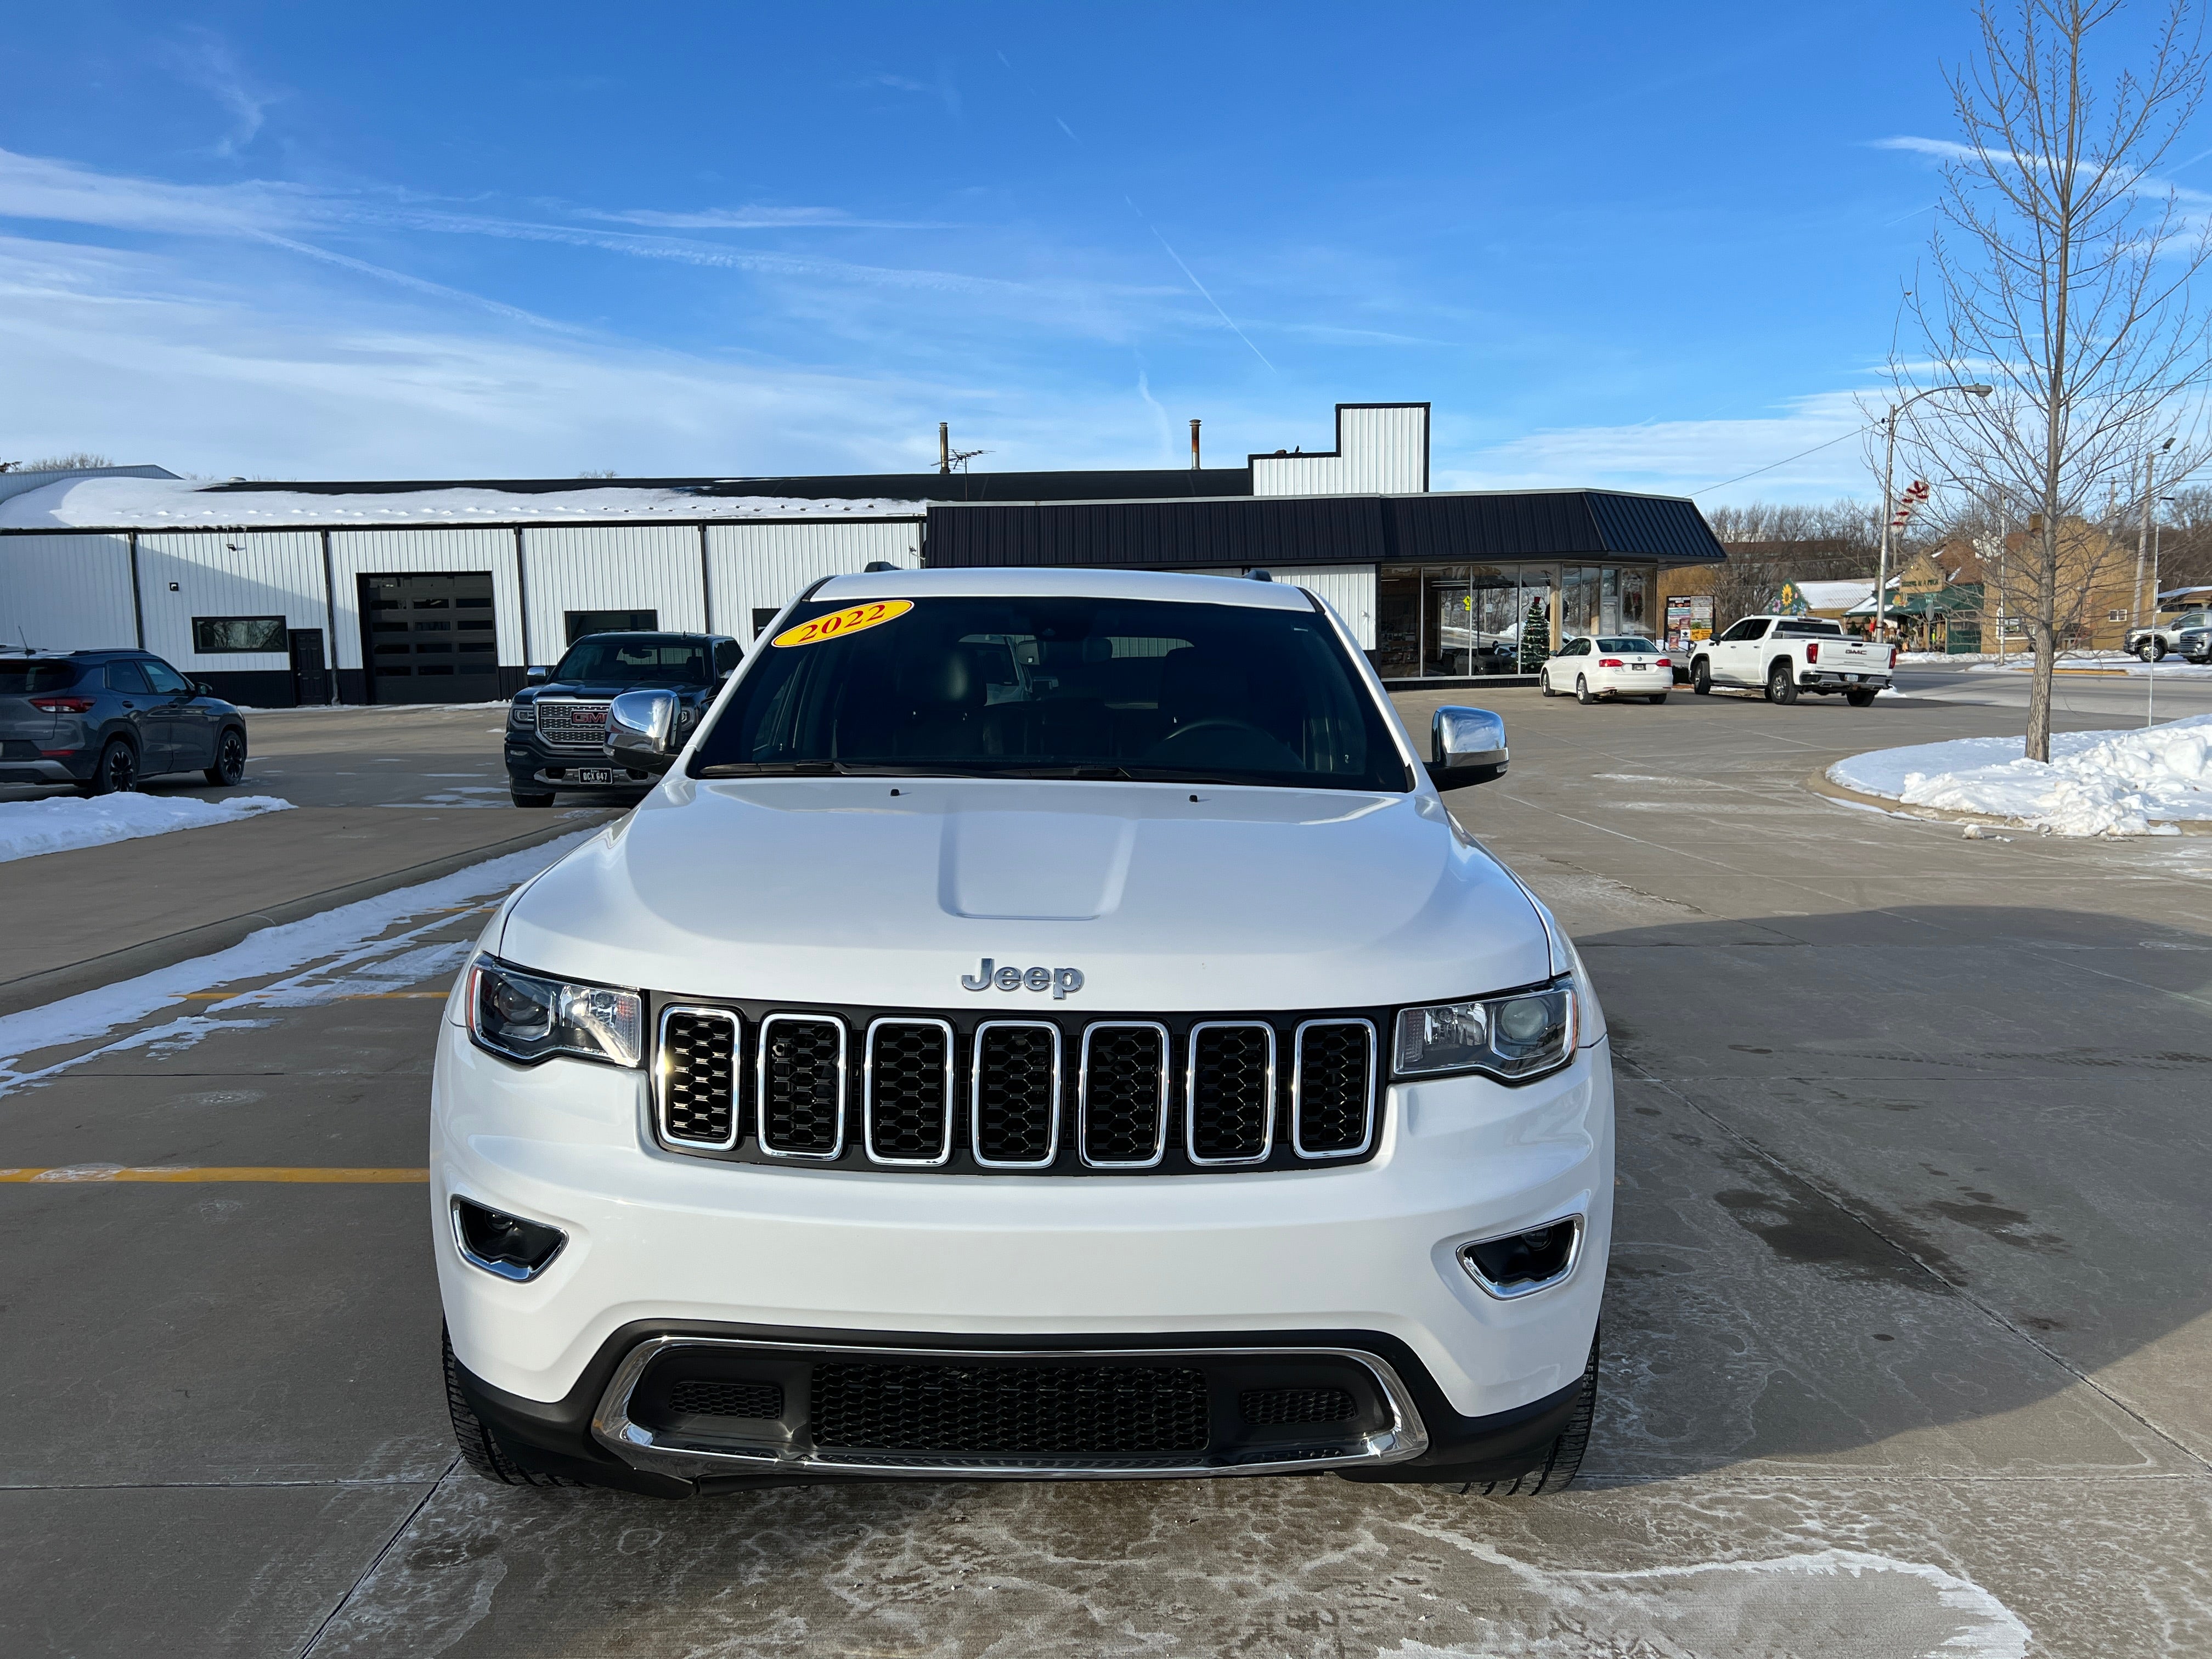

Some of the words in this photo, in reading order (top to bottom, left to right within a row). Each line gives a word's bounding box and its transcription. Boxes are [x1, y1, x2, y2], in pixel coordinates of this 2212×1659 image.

[798, 605, 885, 642] 2022
[596, 772, 607, 781] 647
[962, 958, 1085, 1000] Jeep
